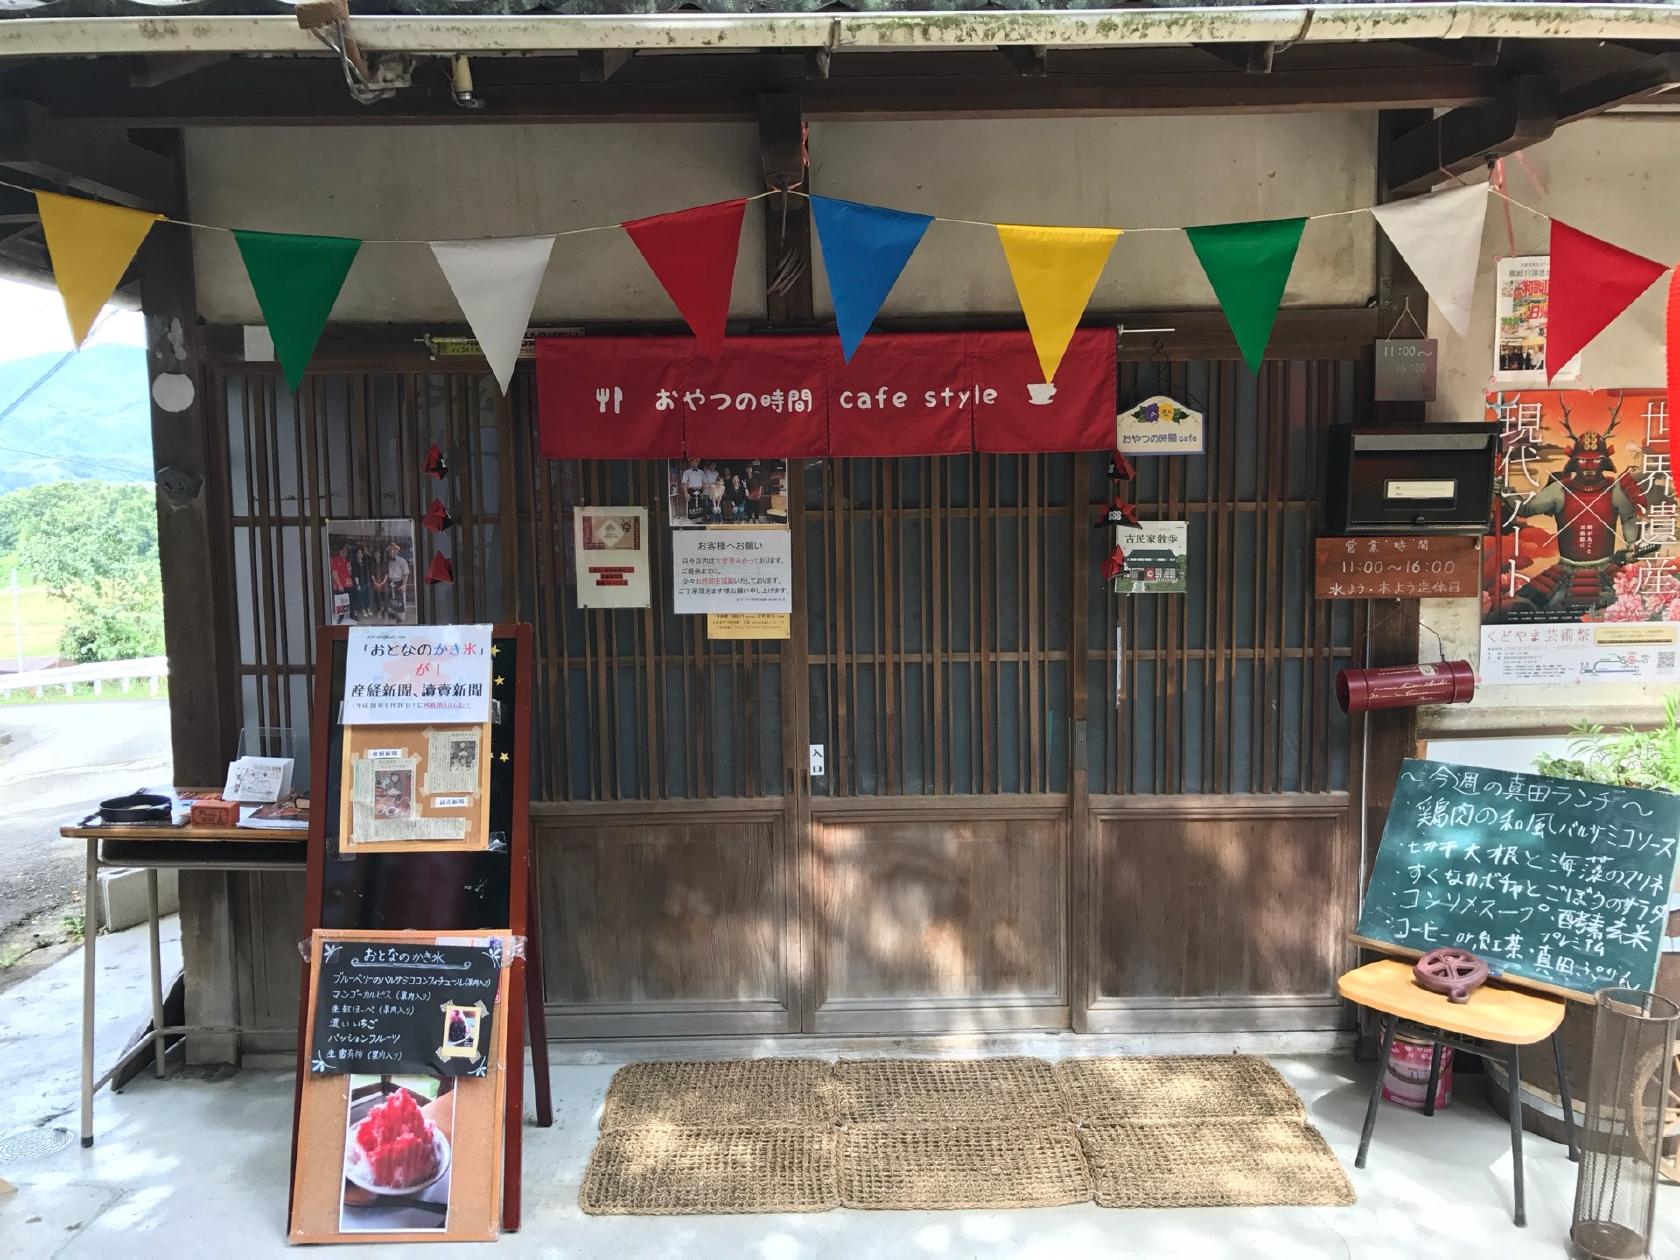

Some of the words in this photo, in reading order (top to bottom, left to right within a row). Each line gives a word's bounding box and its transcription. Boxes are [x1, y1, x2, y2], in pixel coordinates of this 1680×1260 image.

[655, 387, 813, 413] おやつの時間
[840, 386, 908, 409] cafe
[924, 384, 998, 410] style
[1122, 433, 1177, 445] おやつの時間
[1498, 402, 1543, 598] 現代アート
[1633, 401, 1679, 595] 世界遺産
[697, 541, 763, 551] お客様へお願い
[1125, 533, 1178, 544] 古民家散歩
[1345, 538, 1429, 554] 営業時間
[1342, 560, 1455, 574] 11:00～16:00
